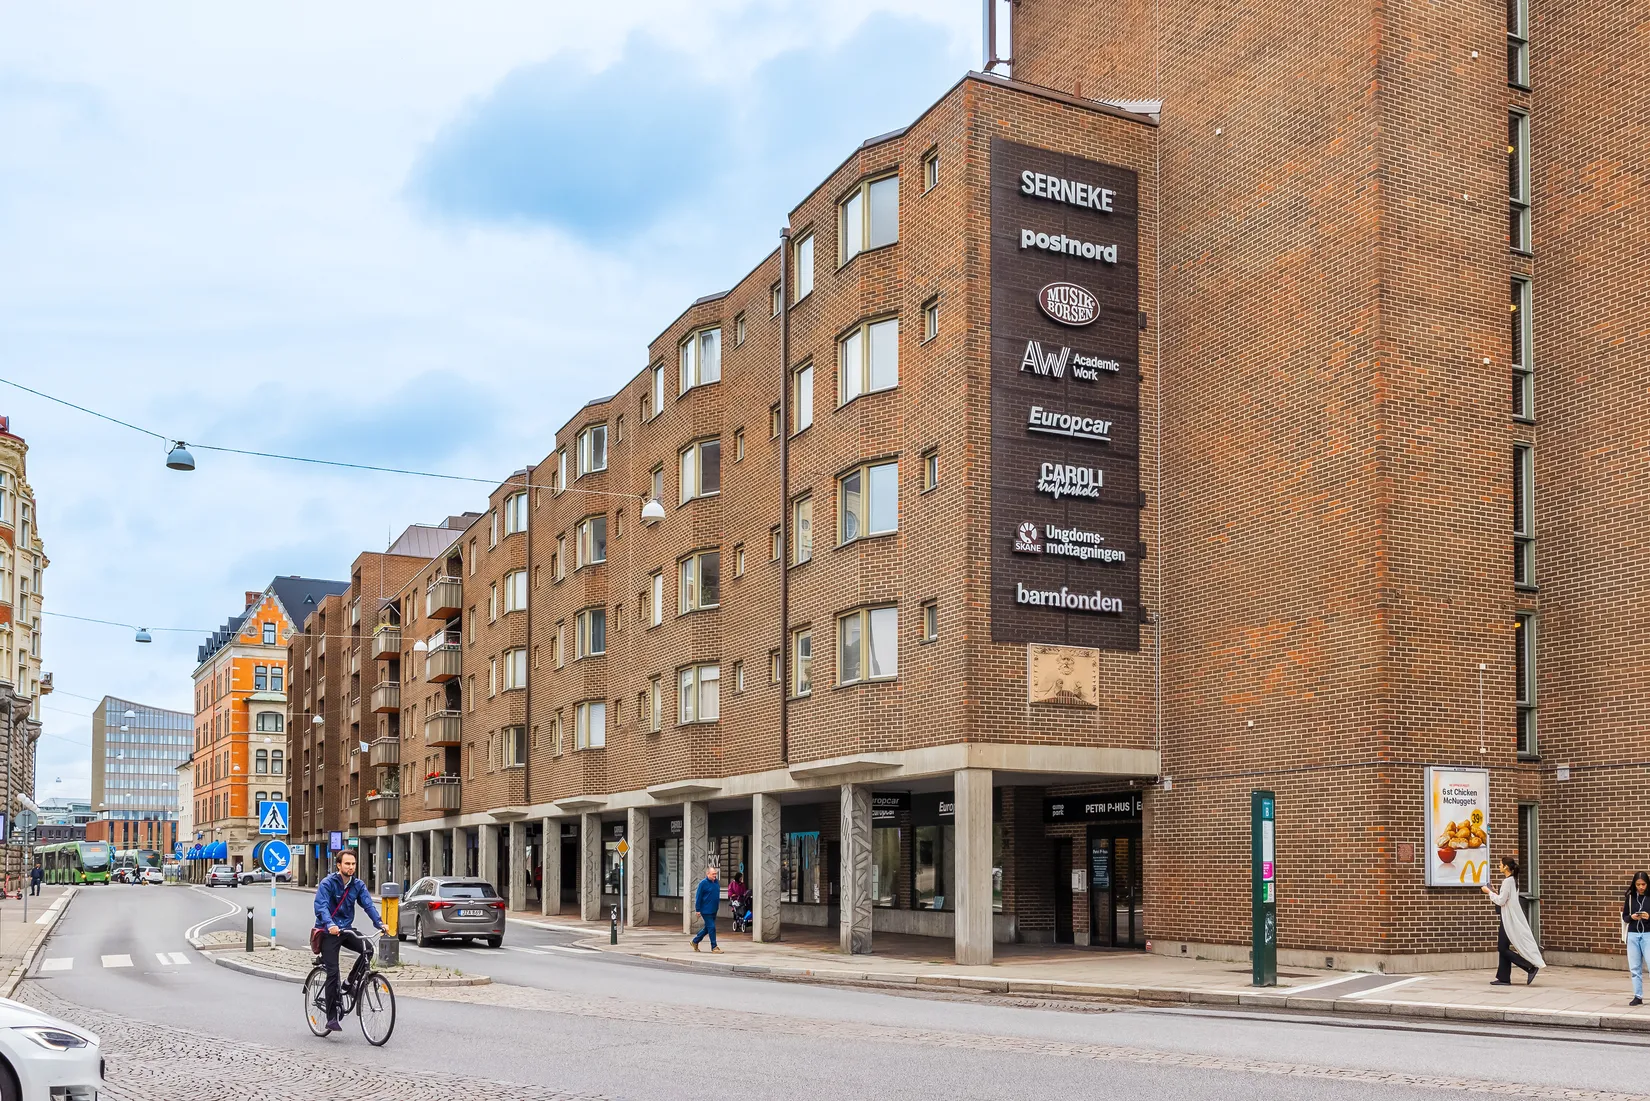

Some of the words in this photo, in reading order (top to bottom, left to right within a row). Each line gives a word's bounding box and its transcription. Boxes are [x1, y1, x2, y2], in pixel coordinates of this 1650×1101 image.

[1021, 170, 1113, 212] SERNEKE
[1021, 229, 1117, 263] postnord
[1047, 286, 1093, 309] MUSIK
[1020, 340, 1070, 378] AW
[1073, 353, 1120, 372] Academic
[1073, 368, 1098, 381] Work
[1029, 406, 1112, 437] Europcar
[1041, 462, 1103, 487] CAROLI
[1046, 525, 1104, 544] Ungdoms-
[1046, 542, 1126, 563] mottagningen
[1017, 582, 1123, 613] barnfonden
[872, 797, 900, 806] ropcar
[1443, 797, 1477, 806] McNuggets
[1454, 788, 1478, 797] Chicken
[1052, 809, 1065, 817] park
[1085, 803, 1106, 813] PETRI
[1107, 801, 1130, 812] P-HUS
